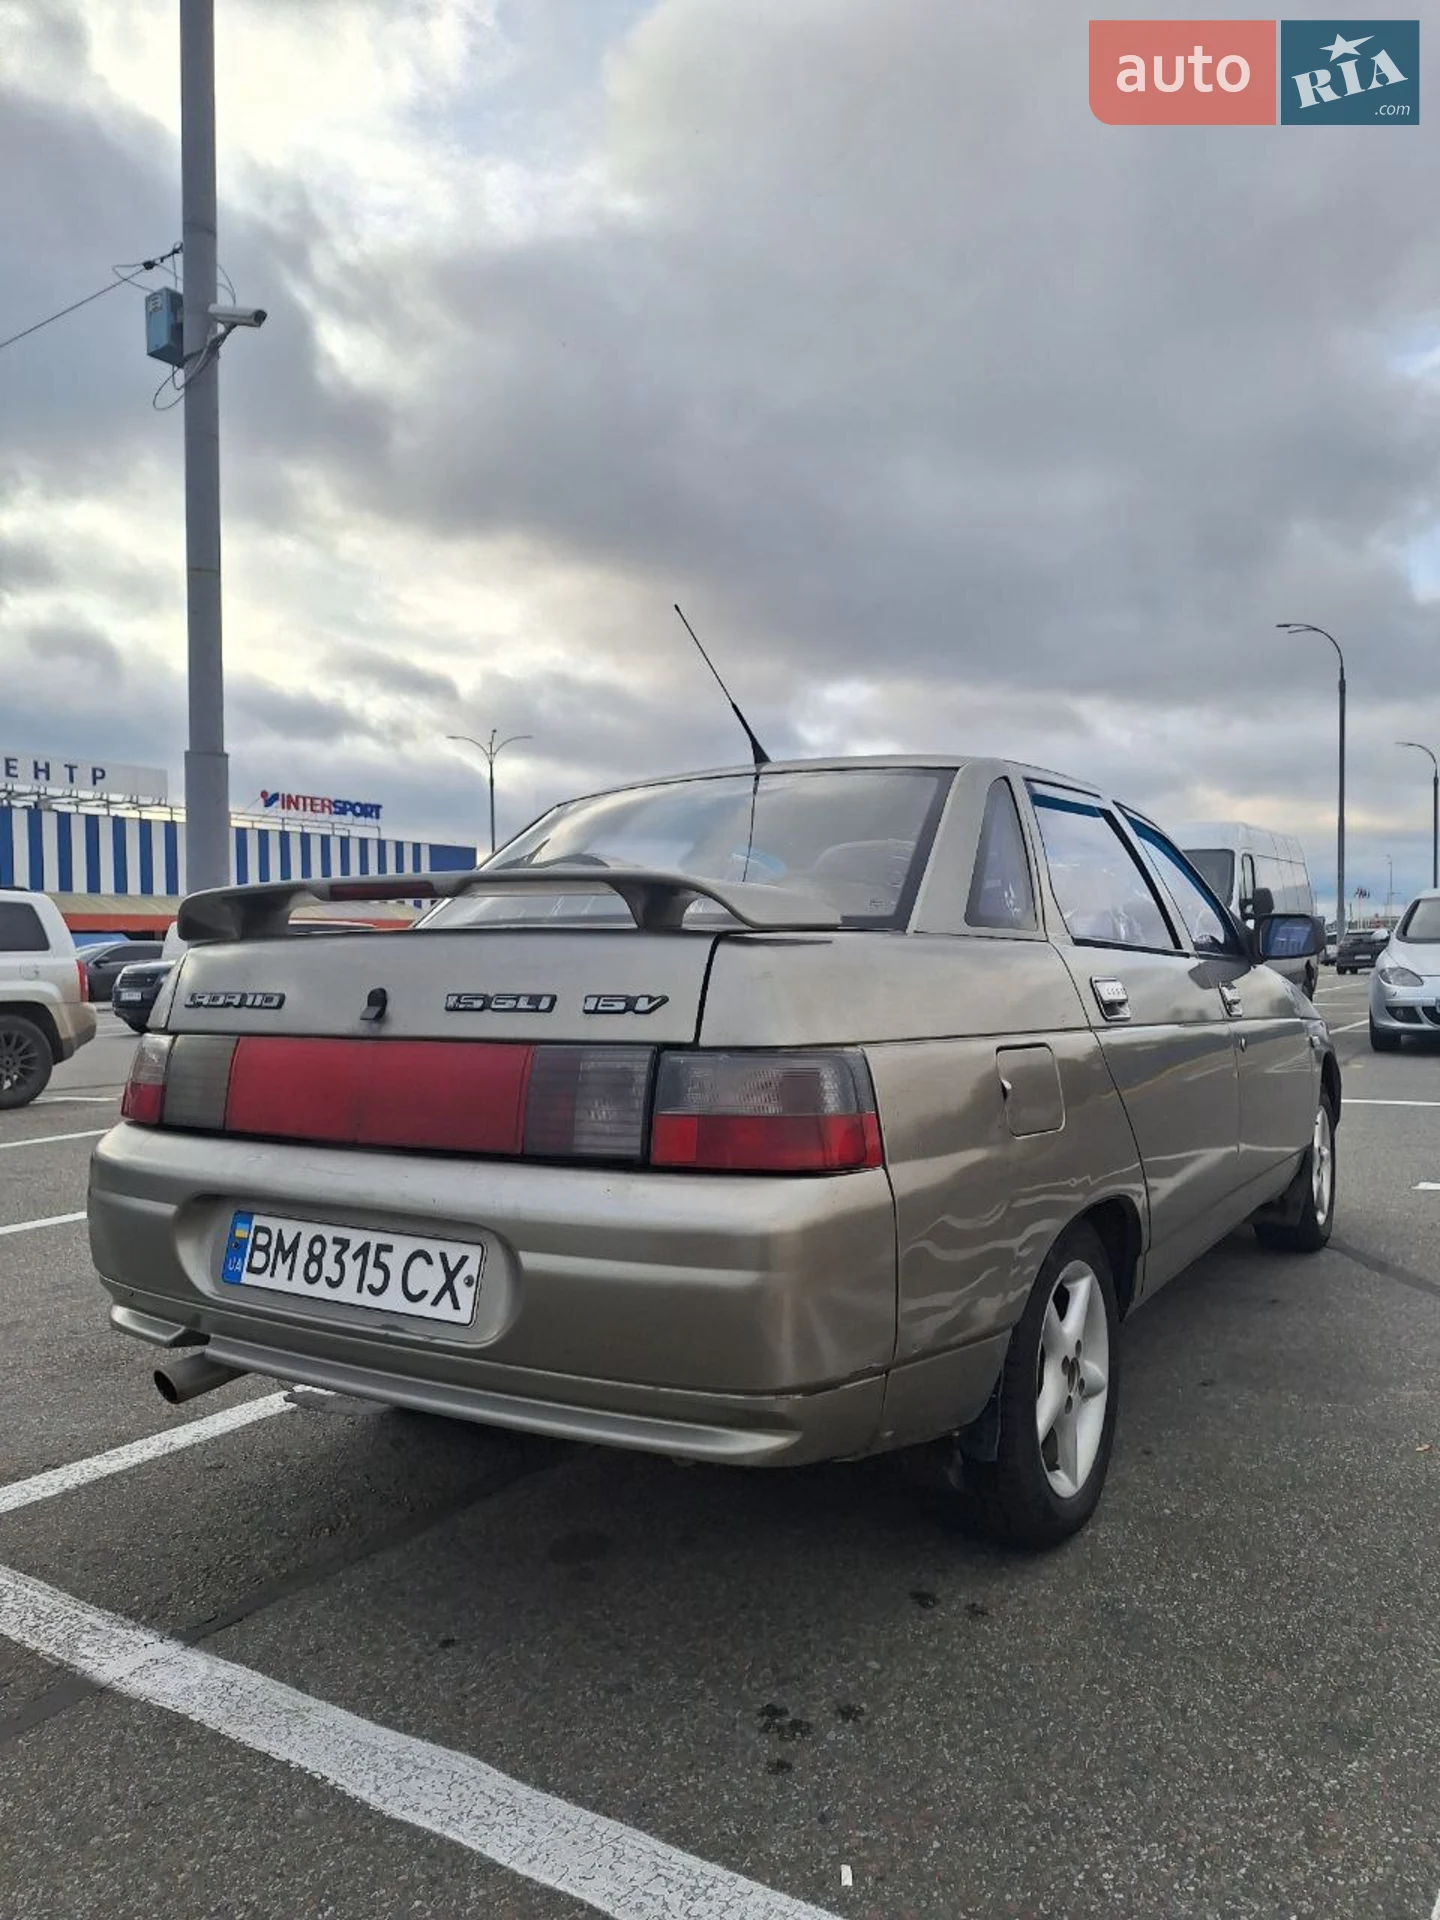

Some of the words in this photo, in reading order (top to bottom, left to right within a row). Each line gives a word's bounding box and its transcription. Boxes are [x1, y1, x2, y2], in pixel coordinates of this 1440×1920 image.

[281, 792, 383, 820] INTERSPORT
[490, 994, 557, 1013] GLI
[228, 1257, 242, 1272] UA
